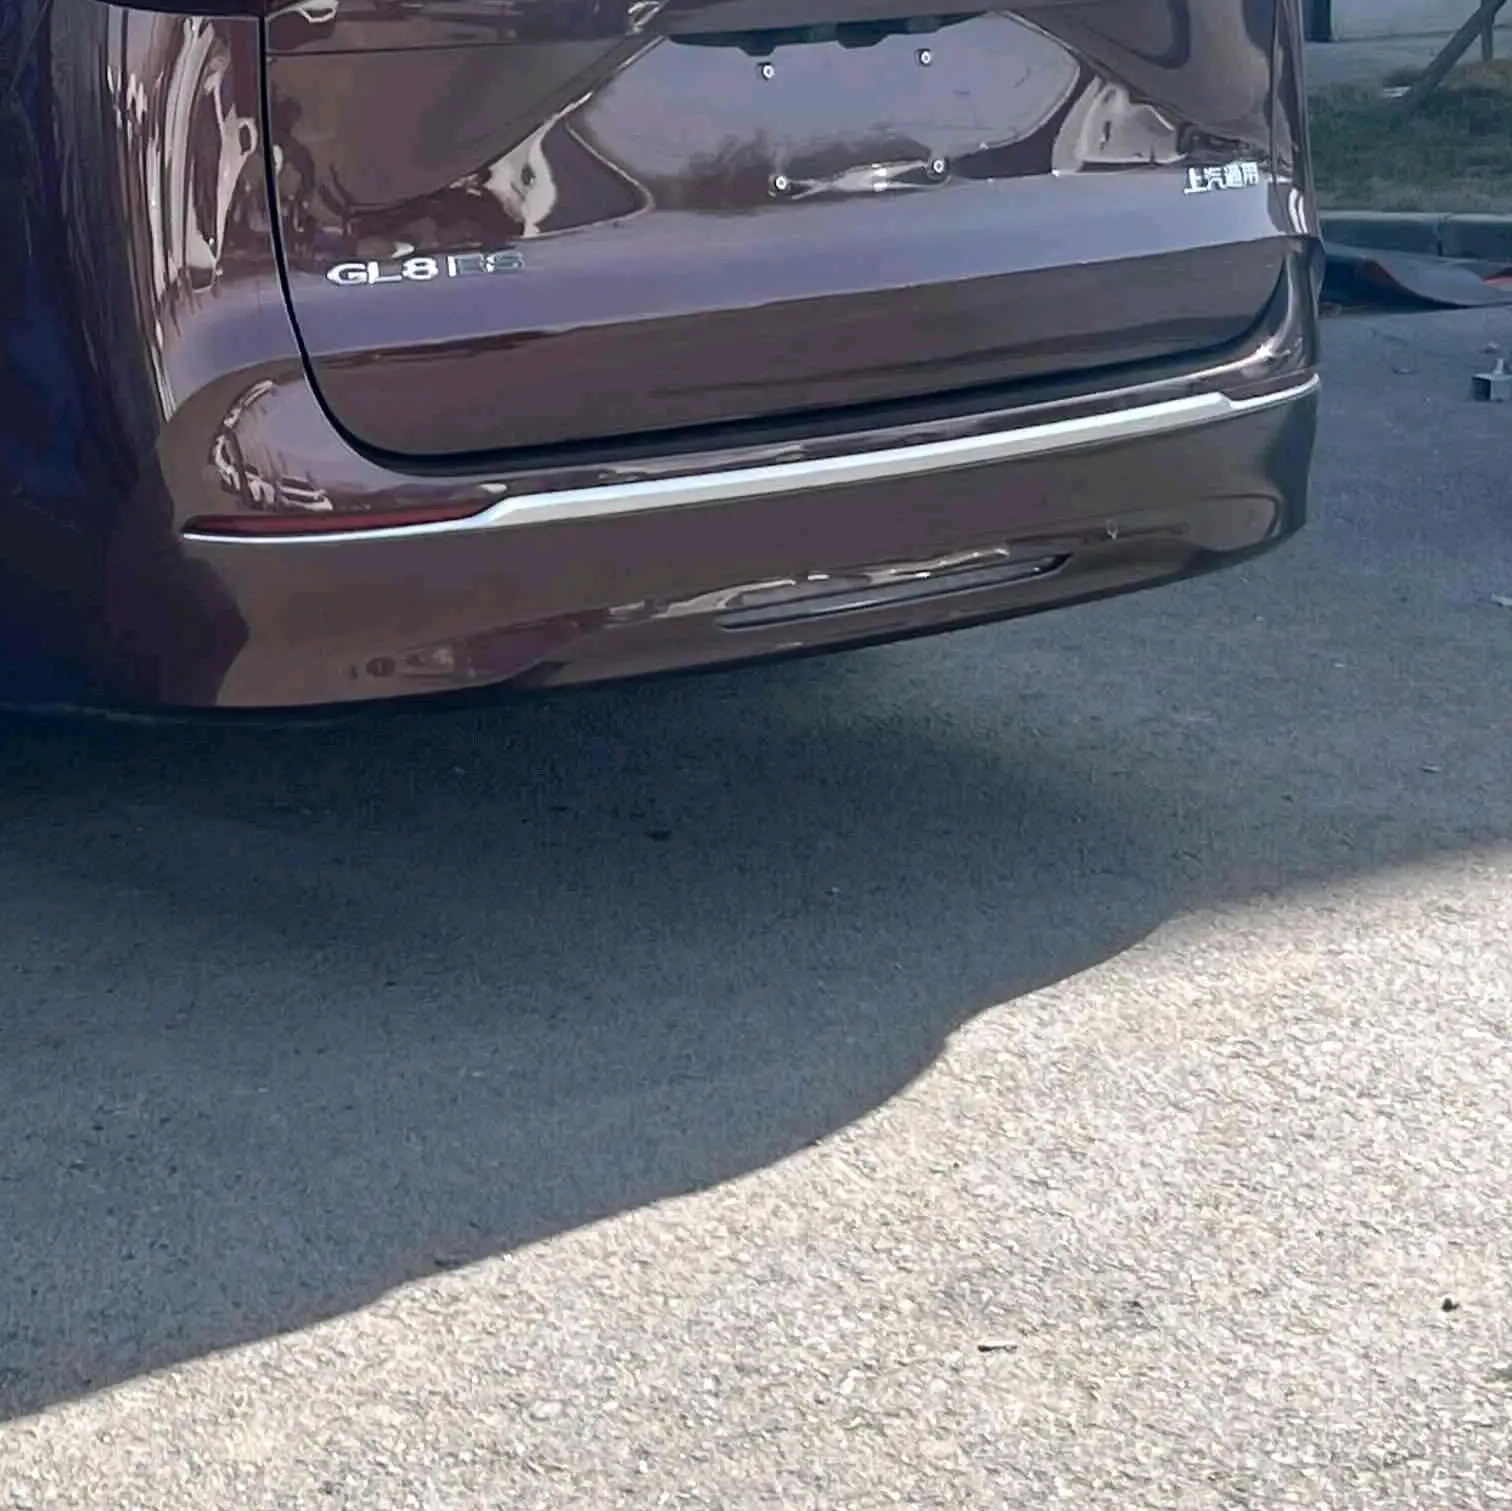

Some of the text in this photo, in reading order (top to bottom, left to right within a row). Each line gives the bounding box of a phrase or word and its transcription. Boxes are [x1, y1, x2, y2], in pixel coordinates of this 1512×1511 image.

[1183, 161, 1259, 194] 上汽通用
[325, 256, 439, 285] GL8
